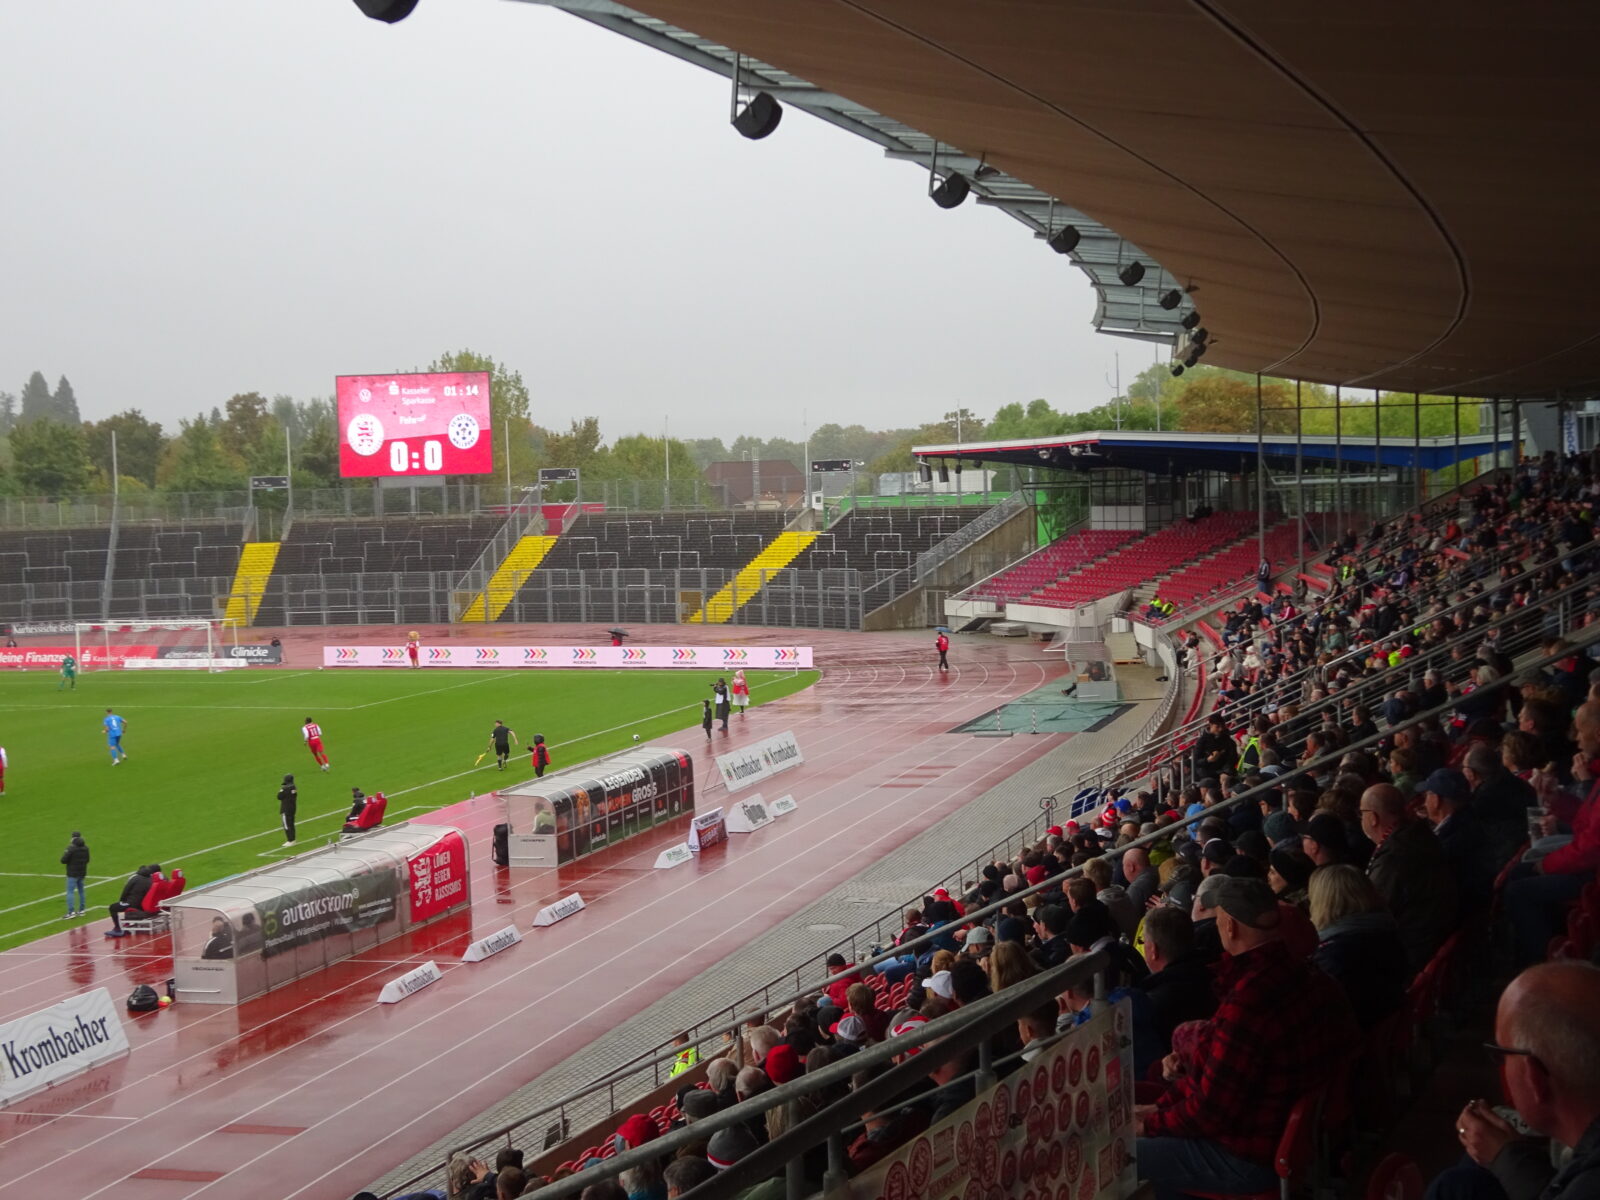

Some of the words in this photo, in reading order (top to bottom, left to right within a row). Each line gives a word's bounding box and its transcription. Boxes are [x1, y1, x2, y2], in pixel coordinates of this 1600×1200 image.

[230, 646, 269, 658] Glinicke
[766, 741, 798, 765] Krombacher
[730, 754, 762, 780] Krombacher
[603, 767, 646, 792] LEGENDEN
[433, 850, 451, 869] LÖWEN
[434, 867, 451, 885] GEGEN
[435, 879, 462, 902] RASSISMUS
[554, 899, 580, 920] Krombacher
[485, 932, 515, 953] Krombacher
[403, 970, 434, 993] Krombacher
[2, 1014, 110, 1078] Krombacher
